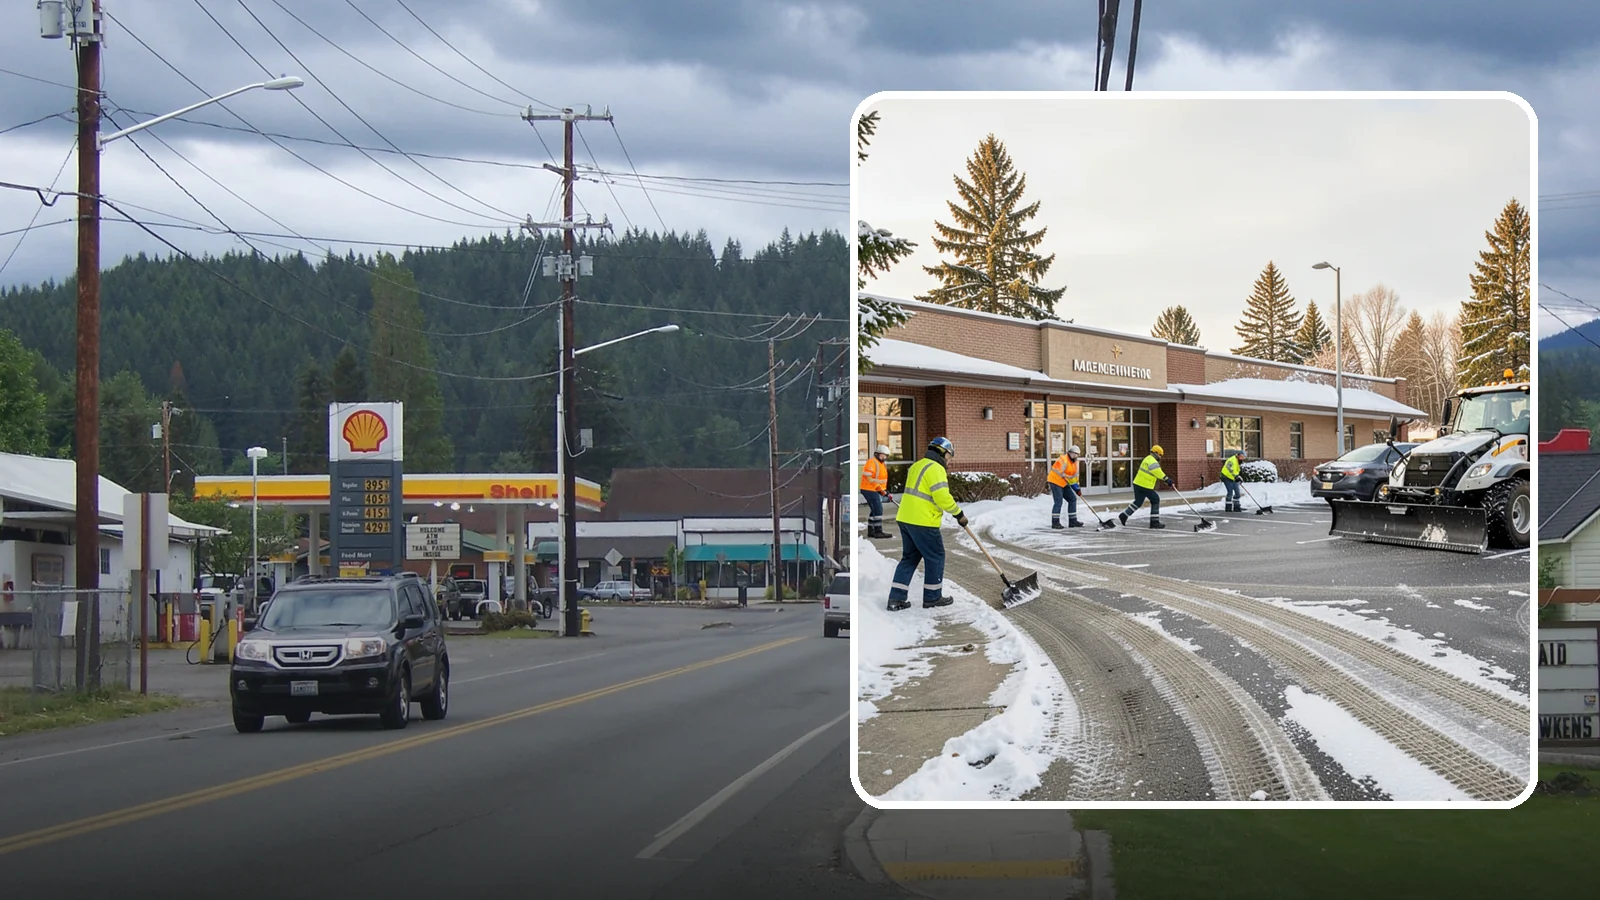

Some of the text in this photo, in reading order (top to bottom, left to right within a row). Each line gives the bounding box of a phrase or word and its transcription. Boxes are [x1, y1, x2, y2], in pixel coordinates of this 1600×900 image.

[365, 480, 384, 490] 395
[490, 484, 547, 499] Shell
[365, 494, 384, 504] 405
[365, 508, 384, 518] 415
[365, 522, 384, 533] 429
[1538, 643, 1567, 666] AID
